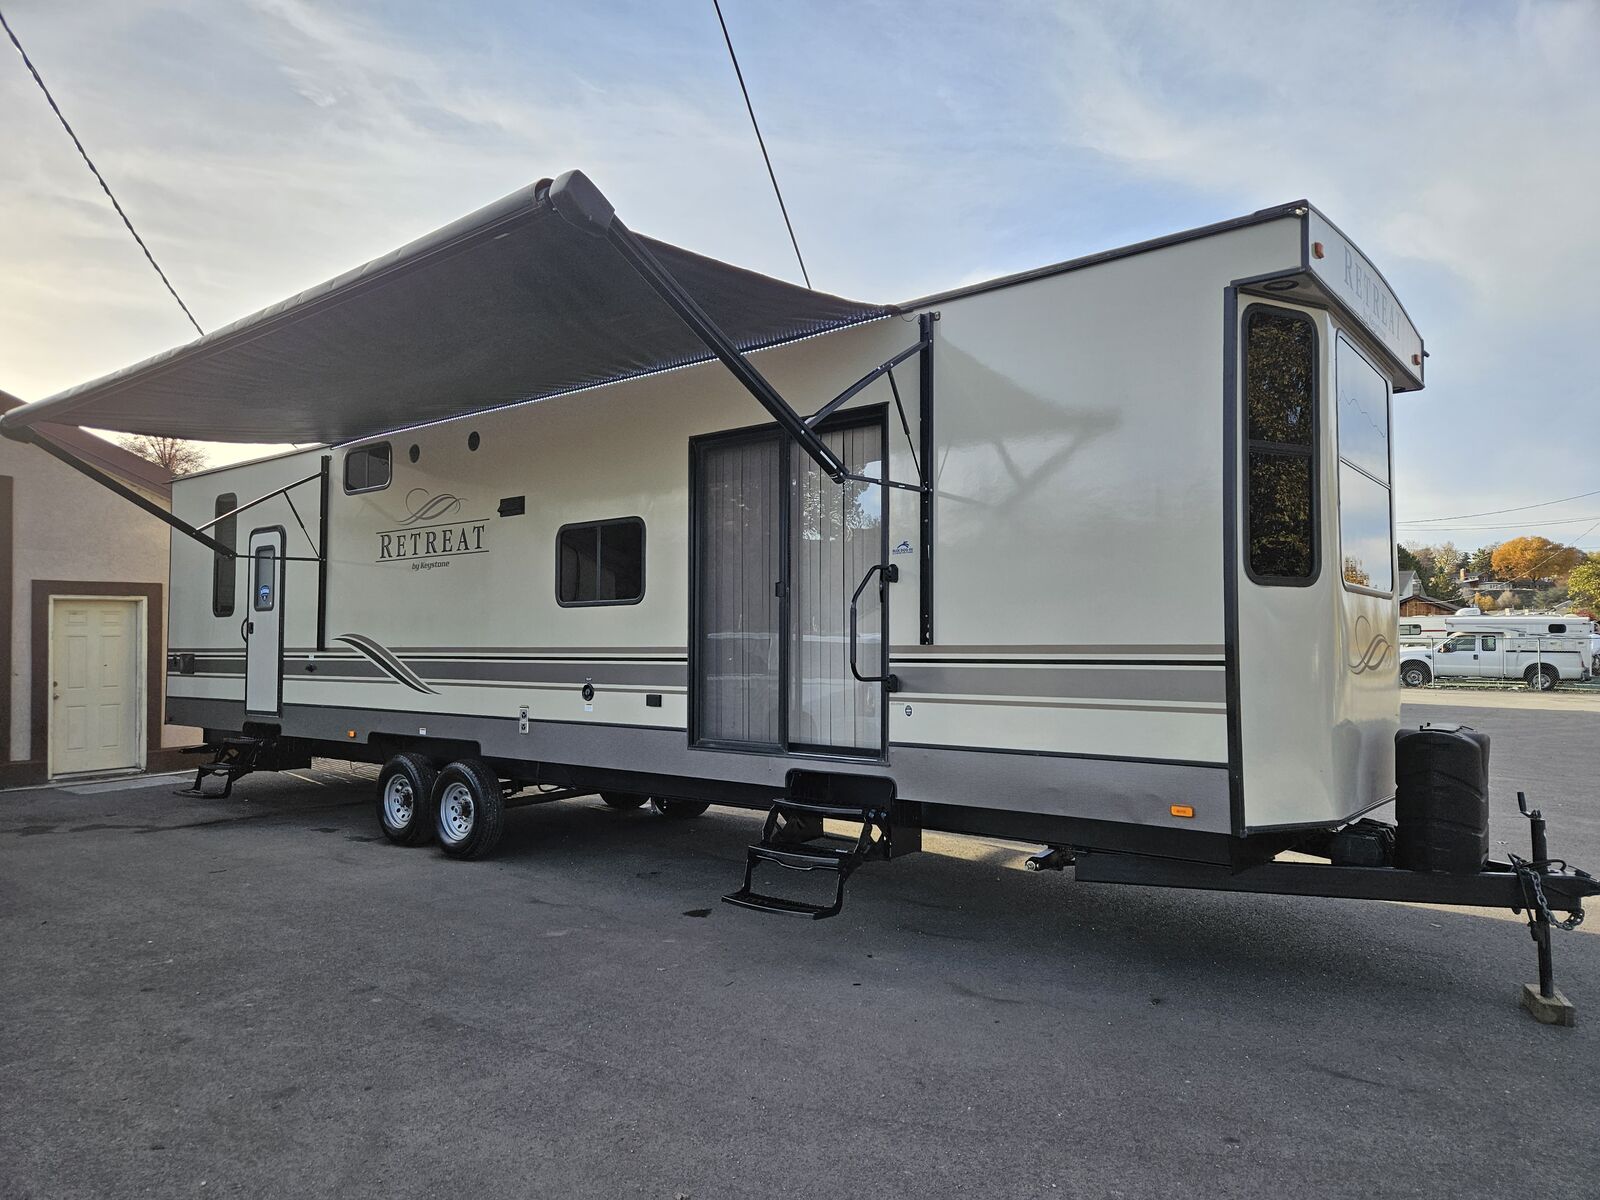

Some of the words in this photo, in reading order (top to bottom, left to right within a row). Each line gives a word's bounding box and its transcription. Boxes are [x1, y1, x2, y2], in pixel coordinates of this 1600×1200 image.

[1343, 245, 1401, 342] RETREAT
[379, 525, 485, 559] RETREAT
[411, 562, 420, 571] by
[420, 561, 450, 570] Keystone
